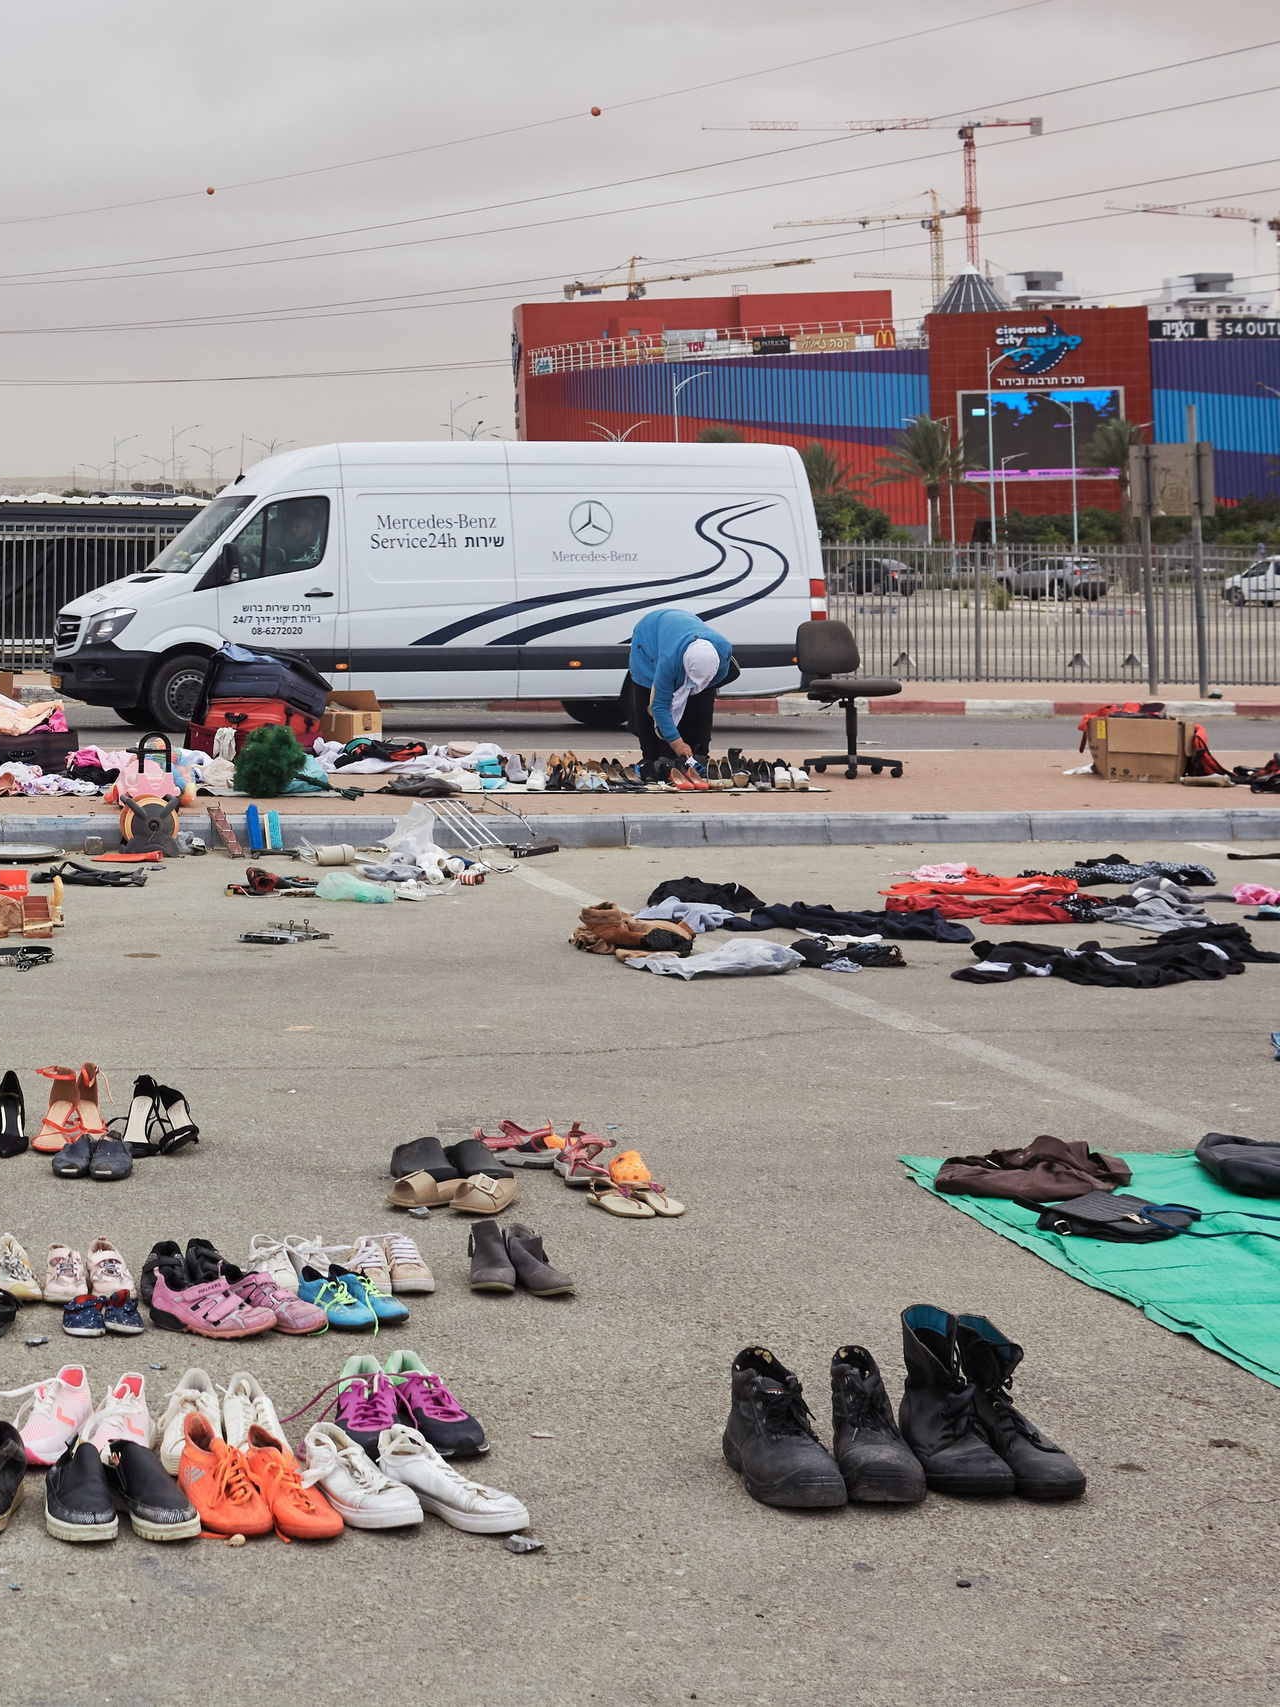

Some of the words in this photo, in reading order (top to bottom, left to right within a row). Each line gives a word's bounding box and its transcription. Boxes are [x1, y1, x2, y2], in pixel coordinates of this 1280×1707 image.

[995, 325, 1047, 335] cinema
[1225, 322, 1243, 335] 54
[1246, 322, 1280, 335] OUT
[829, 337, 850, 350] קפה
[995, 335, 1024, 346] city
[1026, 335, 1083, 350] סינמה
[997, 378, 1025, 387] ובידור
[1027, 377, 1058, 386] תרבות
[1061, 376, 1085, 385] מרכז
[376, 513, 497, 530] Mercedes-Benz
[464, 535, 505, 548] שירות
[552, 551, 638, 562] Mercedes-Benz
[242, 604, 263, 612] ברוש
[265, 604, 289, 612] שירות
[291, 604, 311, 612] מרכז
[233, 615, 253, 624] 24/7
[255, 616, 270, 625] דרך
[273, 616, 297, 625] תיקוני
[300, 615, 321, 623] ניידת
[251, 627, 303, 635] 08-6272020
[198, 1282, 222, 1294] WALKERS
